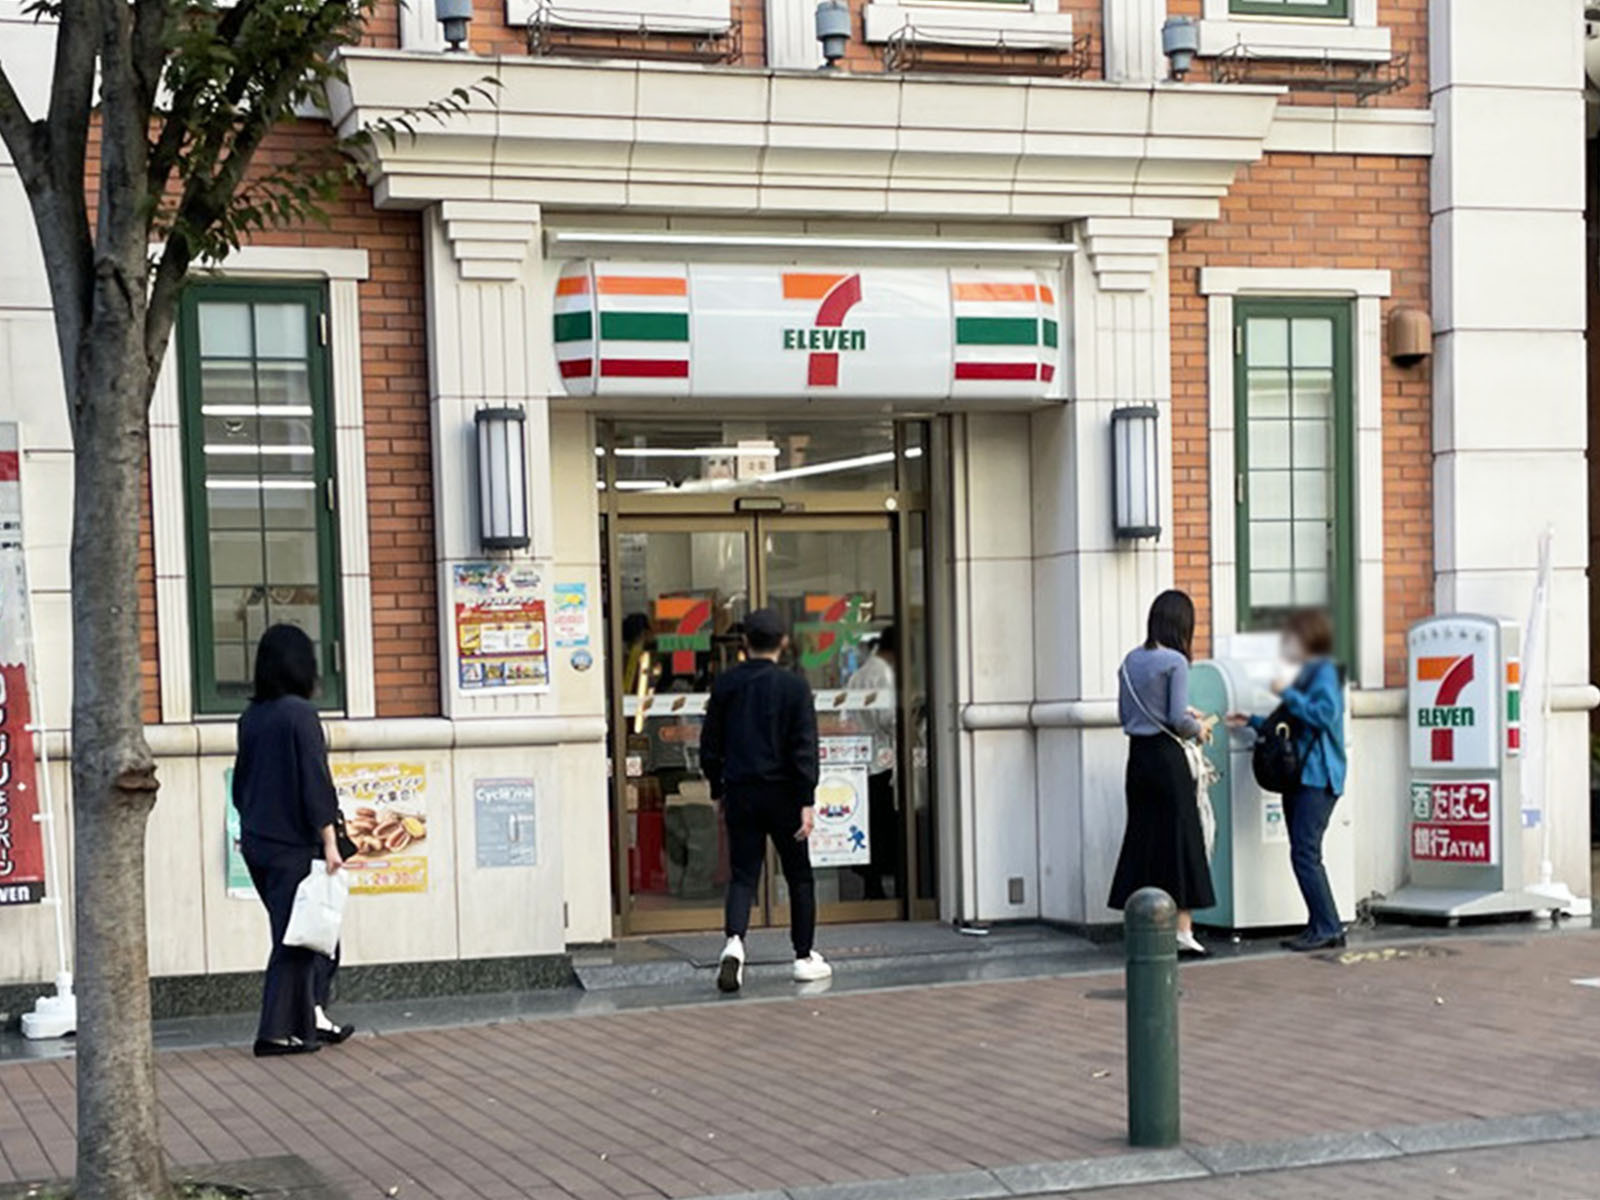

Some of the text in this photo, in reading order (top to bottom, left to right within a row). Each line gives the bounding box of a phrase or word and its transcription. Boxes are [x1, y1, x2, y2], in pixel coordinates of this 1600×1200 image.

[782, 273, 862, 386] 7
[1417, 653, 1474, 762] 7
[1433, 786, 1488, 819] たばこ
[1415, 827, 1485, 857] 銀行ATM
